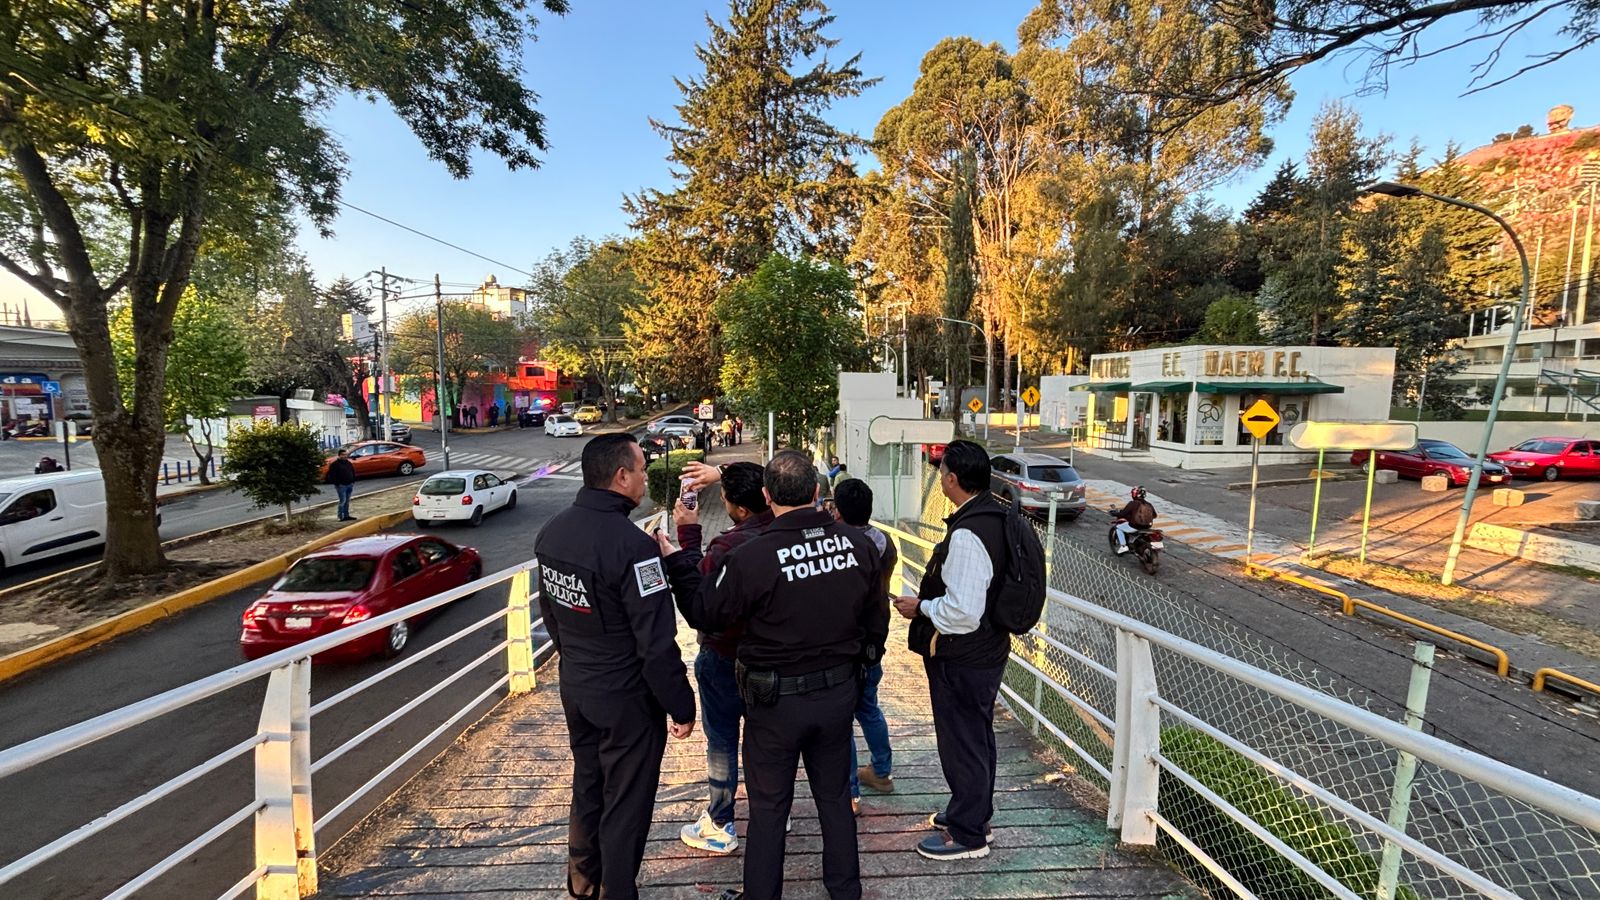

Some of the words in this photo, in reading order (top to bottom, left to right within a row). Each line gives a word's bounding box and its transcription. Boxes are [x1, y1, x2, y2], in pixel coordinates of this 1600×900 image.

[776, 534, 854, 564] POLICÍA
[541, 564, 588, 593] POLICÍA
[781, 552, 859, 582] TOLUCA
[543, 578, 591, 607] TOLUCA
